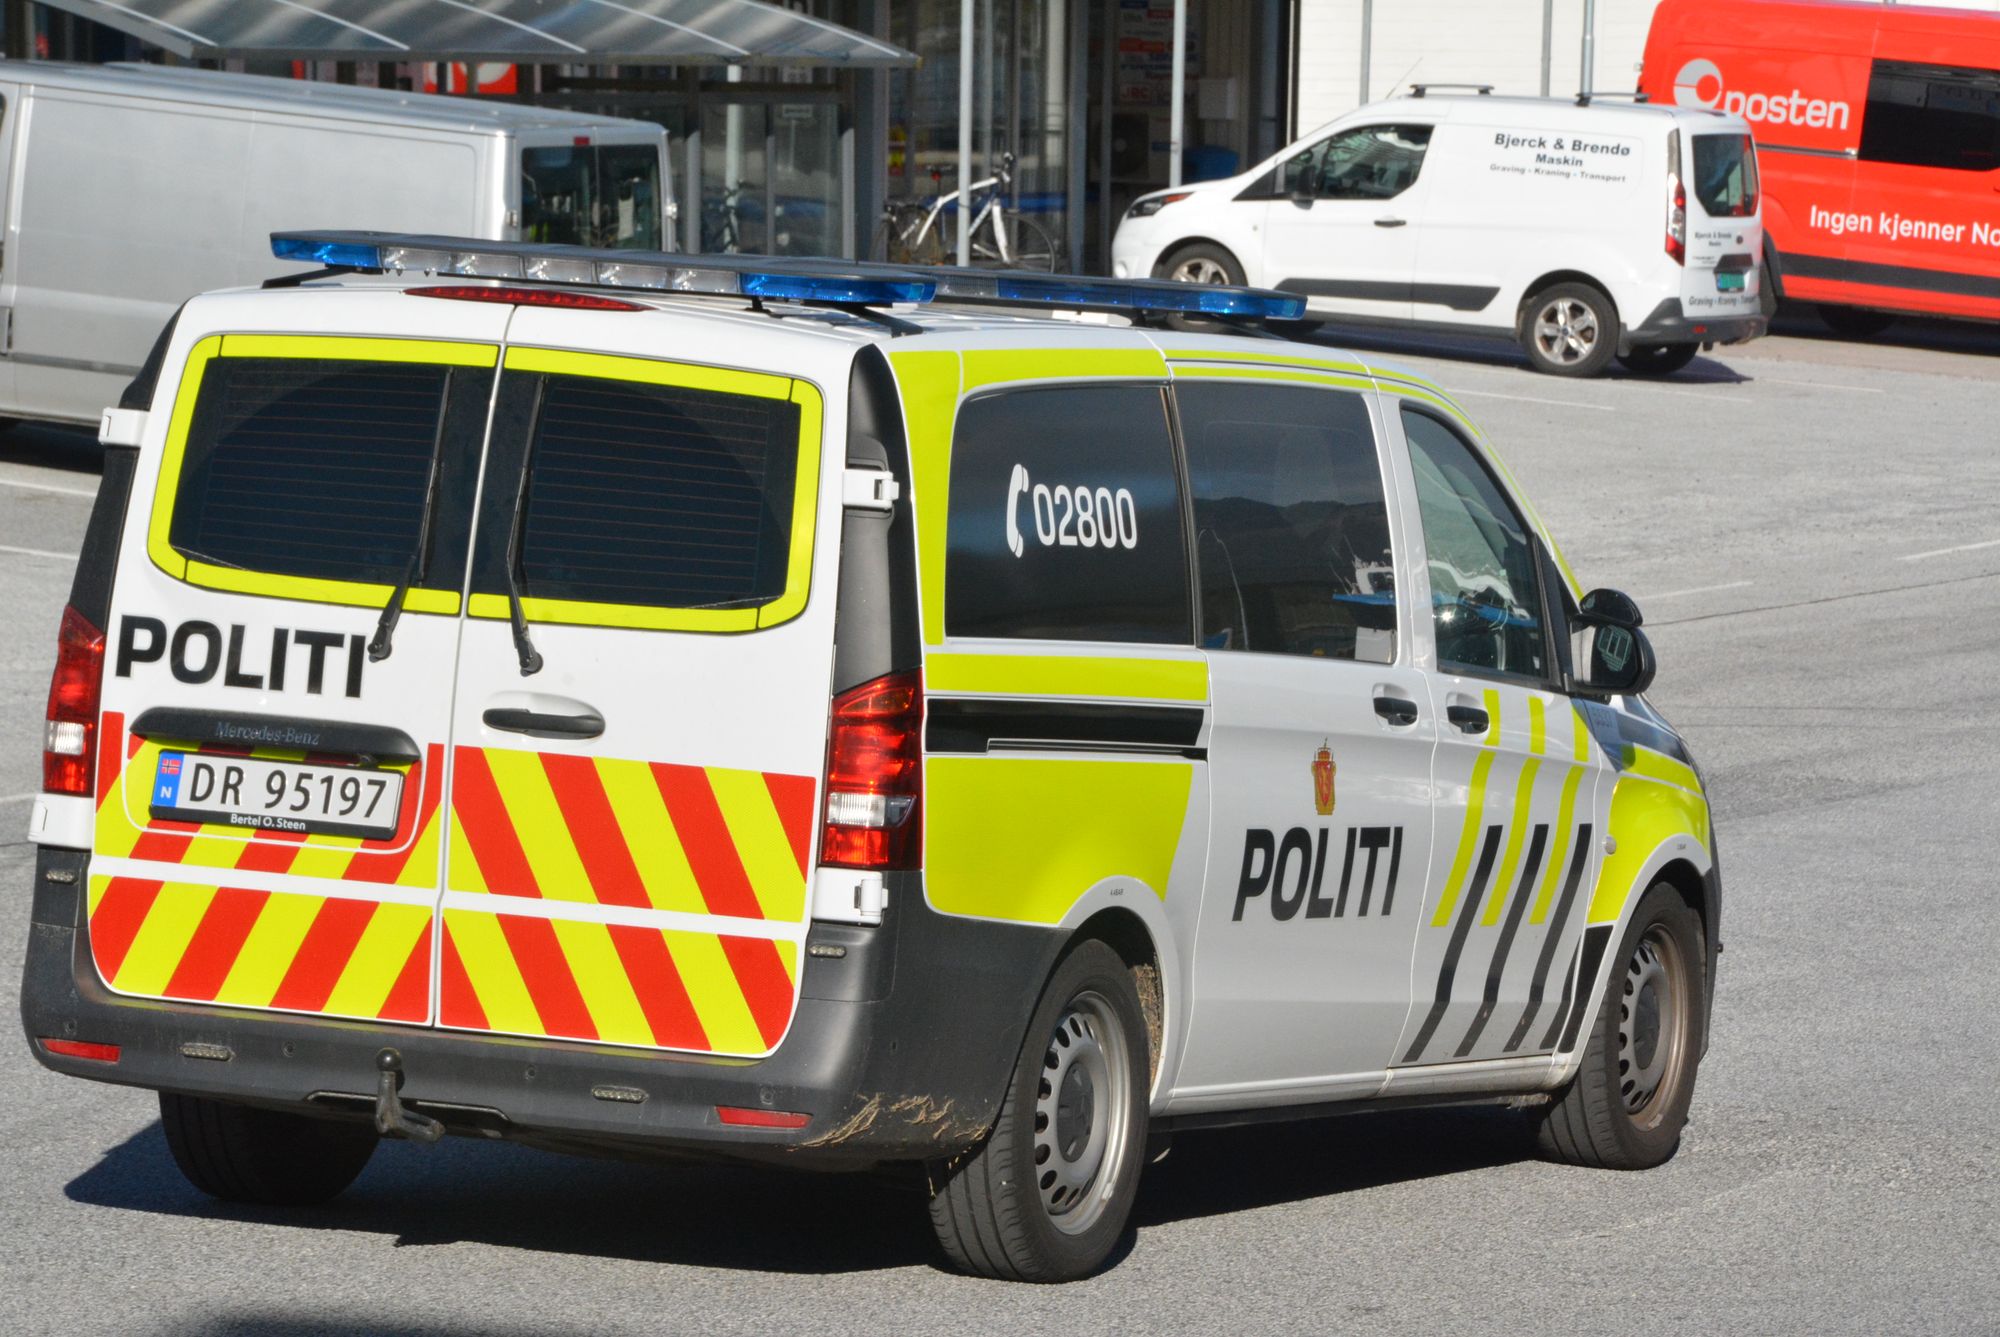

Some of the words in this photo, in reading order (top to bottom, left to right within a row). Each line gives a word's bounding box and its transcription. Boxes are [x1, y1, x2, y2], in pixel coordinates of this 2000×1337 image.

[1724, 89, 1850, 130] posten
[1494, 133, 1547, 149] Bjerck
[1553, 138, 1565, 150] &
[1572, 139, 1631, 156] Brendø
[1535, 153, 1584, 167] Maskin
[1490, 163, 1526, 175] Graving
[1534, 167, 1571, 179] Kraning
[1580, 171, 1626, 183] Transport
[1809, 204, 1873, 235] Ingen
[1878, 211, 1966, 241] kjenner
[1033, 483, 1137, 549] 02800
[115, 614, 366, 698] POLITI
[215, 721, 321, 746] Mercedes-Benz
[160, 786, 172, 799] N
[189, 762, 244, 806] DR
[264, 769, 387, 818] 95197
[230, 813, 261, 828] Bertel
[263, 816, 275, 828] O.
[277, 817, 306, 831] Steen
[1232, 826, 1403, 922] POLITI
